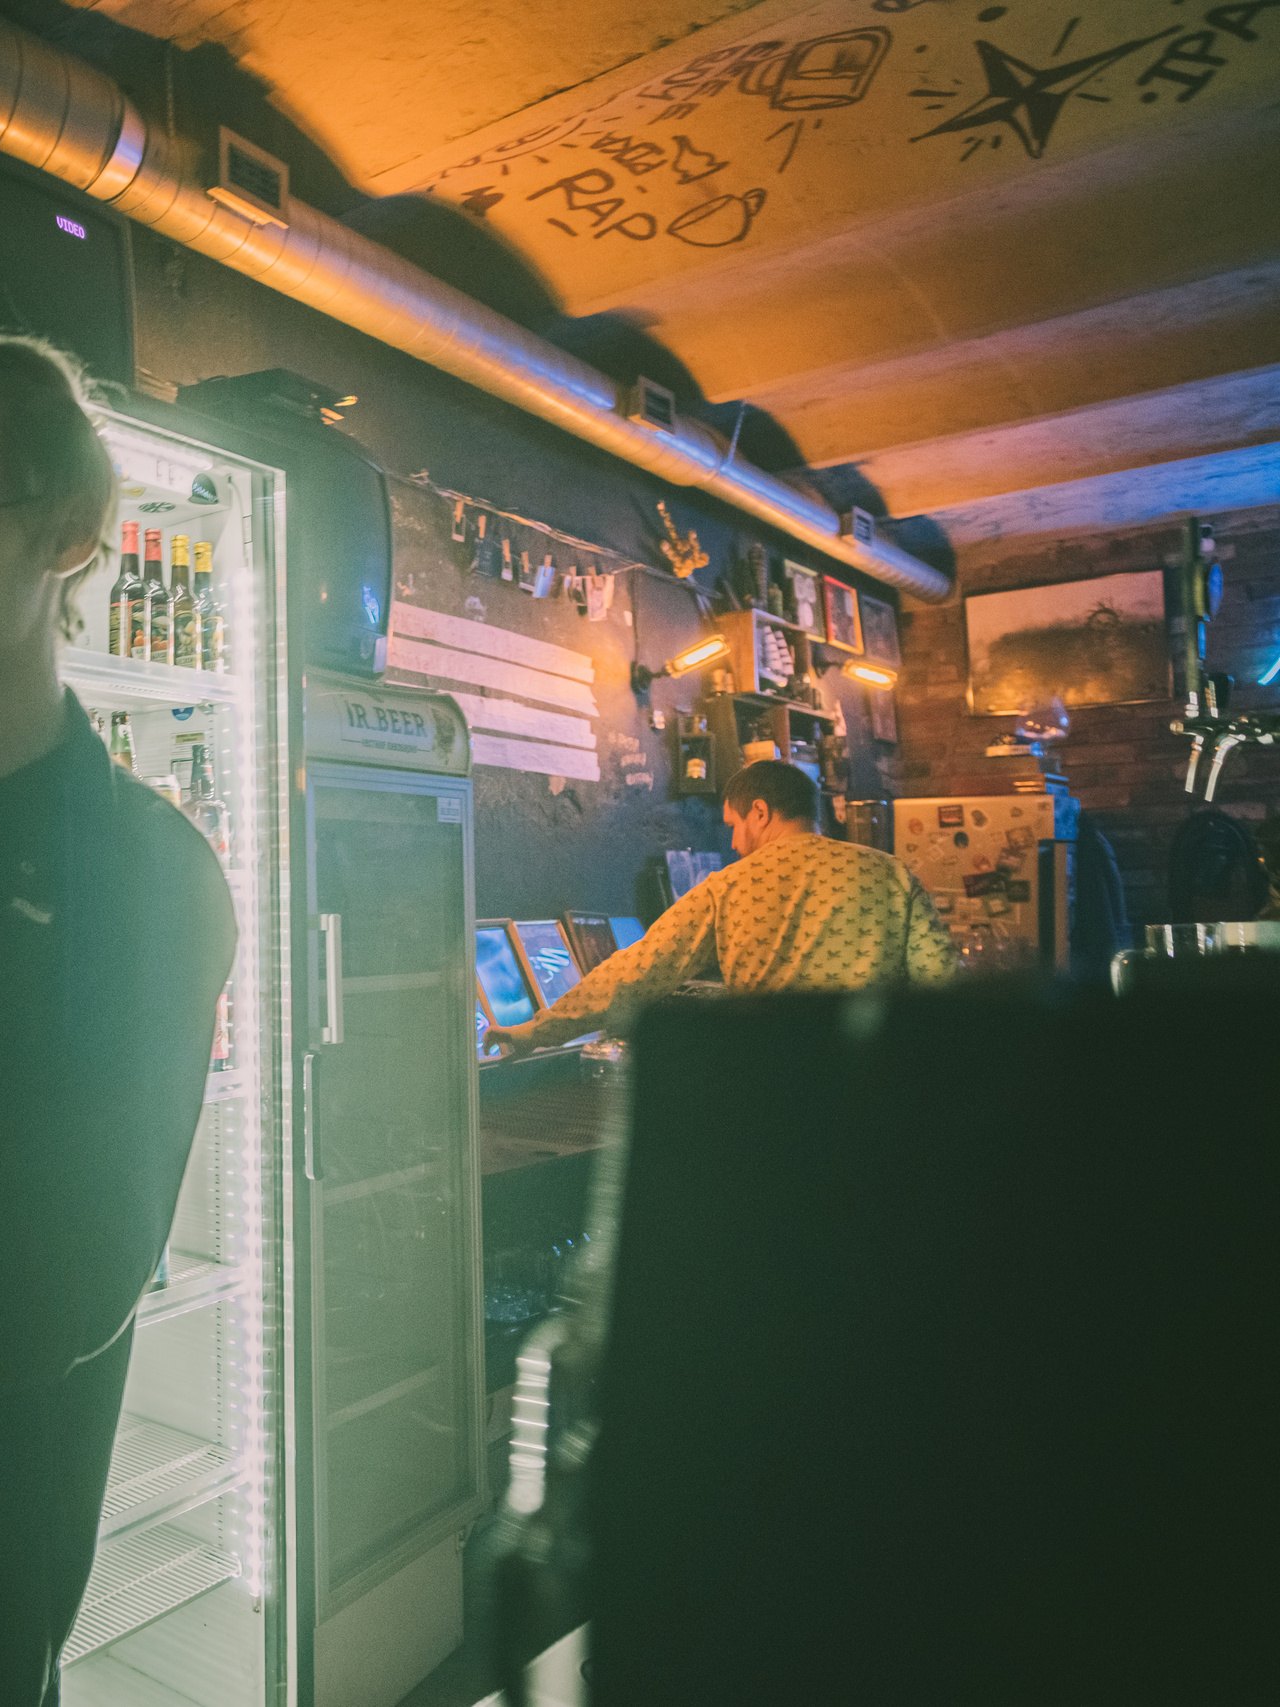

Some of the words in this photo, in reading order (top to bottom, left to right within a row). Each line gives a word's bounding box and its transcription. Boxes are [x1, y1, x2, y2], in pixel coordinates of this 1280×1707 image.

[1137, 0, 1280, 102] IPA
[55, 215, 86, 240] VIDEO
[526, 167, 658, 241] RAP
